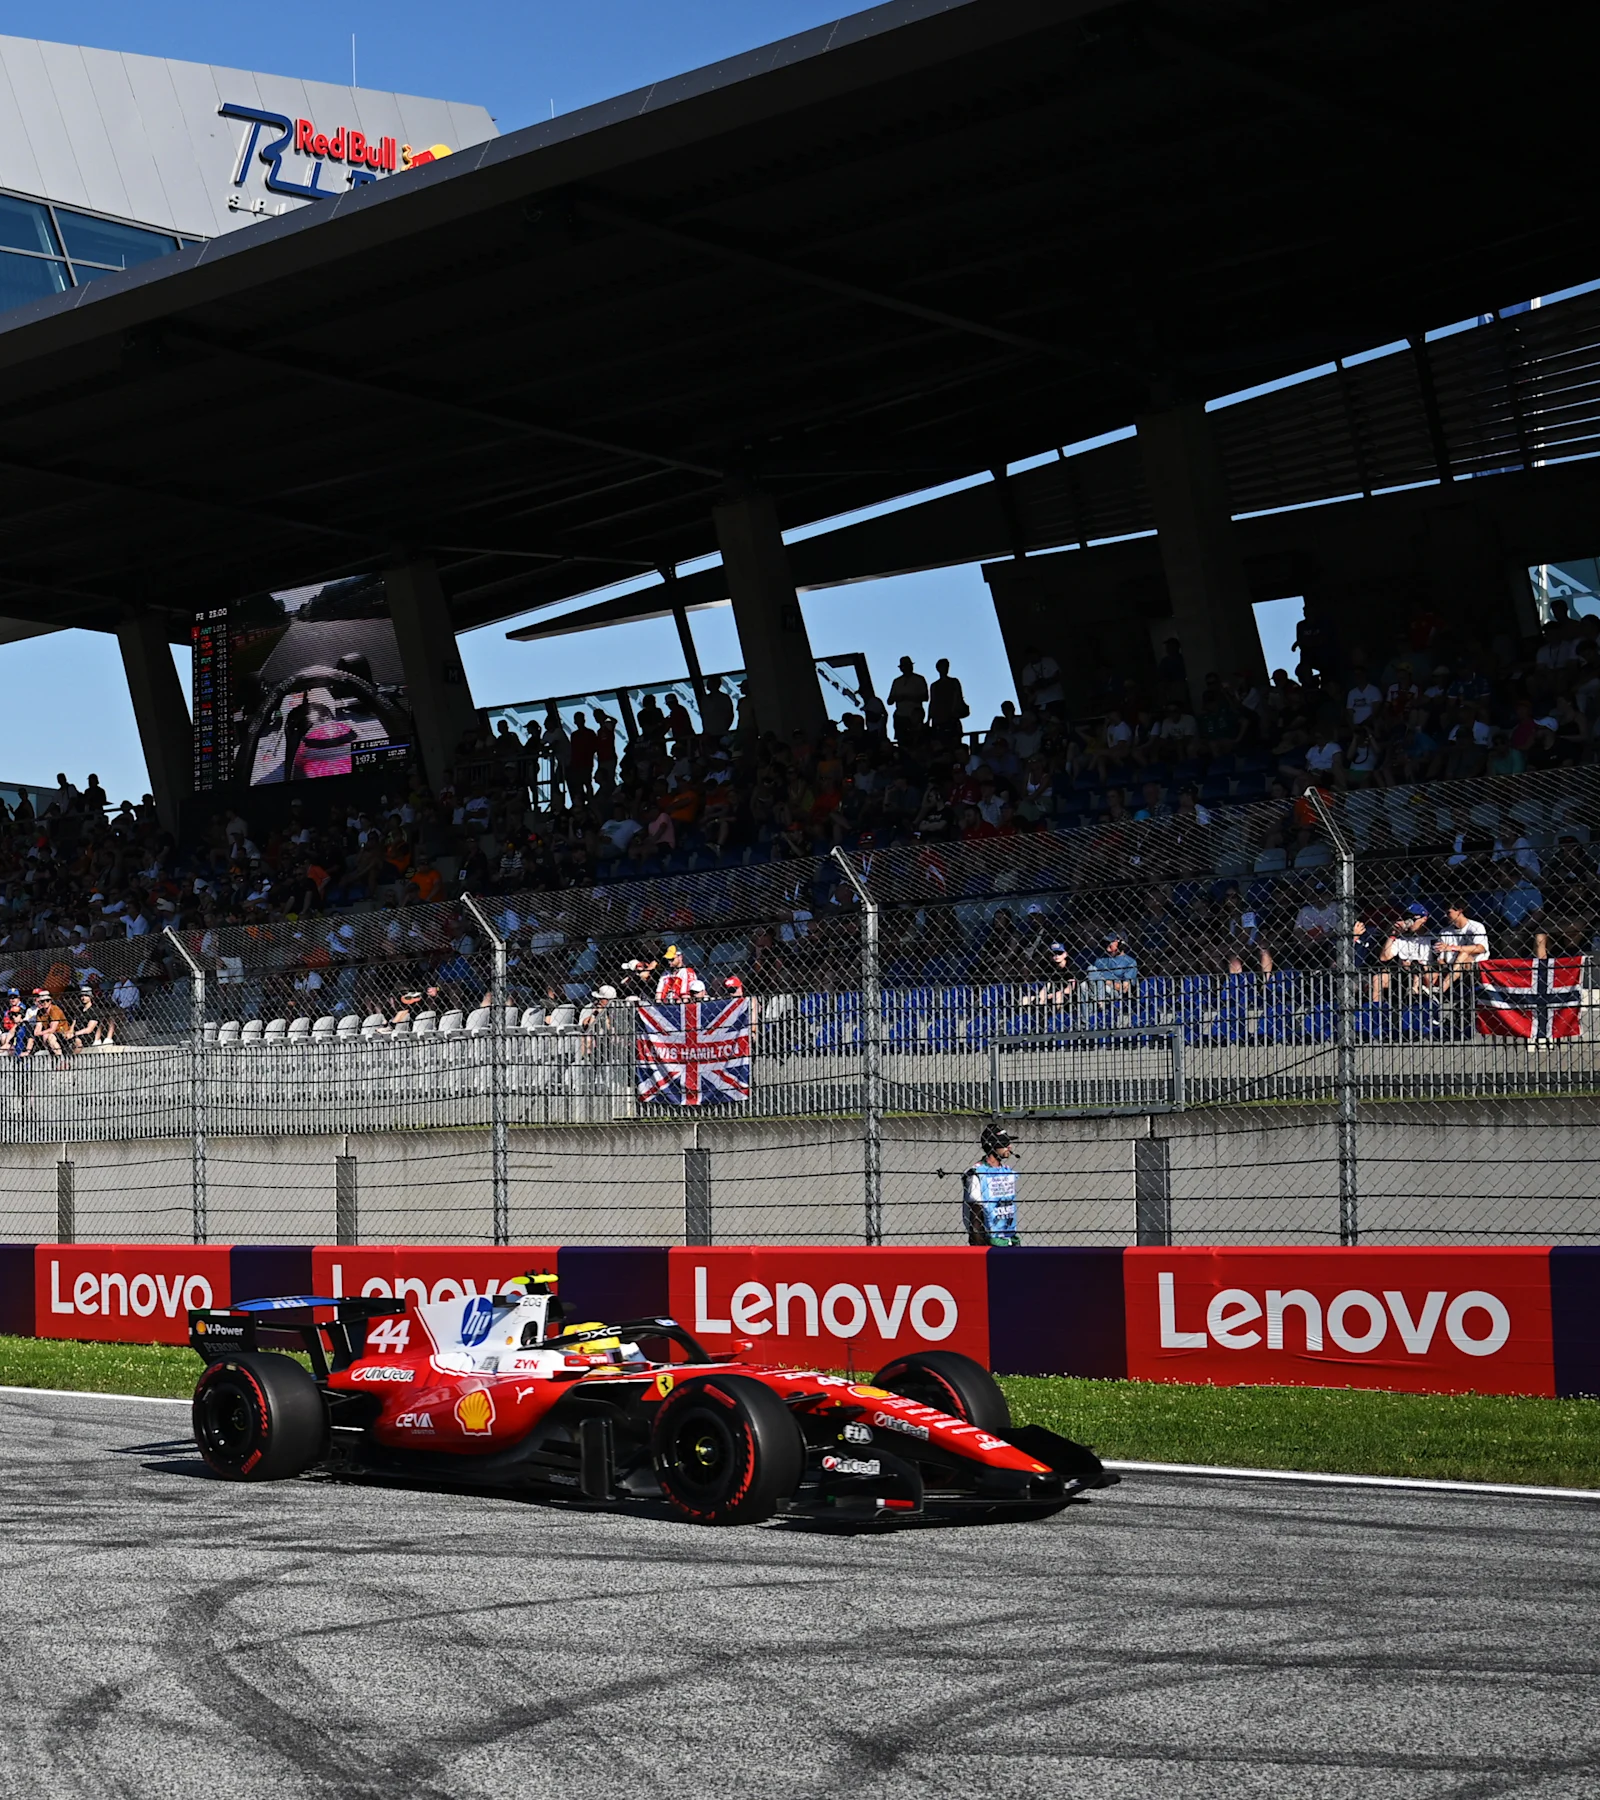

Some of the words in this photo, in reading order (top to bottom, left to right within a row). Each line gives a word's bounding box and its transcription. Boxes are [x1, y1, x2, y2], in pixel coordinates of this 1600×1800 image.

[297, 119, 345, 159] Red
[348, 131, 396, 171] Bull
[50, 1261, 214, 1317] Lenovo
[695, 1266, 958, 1341] Lenovo
[205, 1324, 244, 1336] V-Power
[463, 1297, 491, 1347] hp
[1158, 1272, 1510, 1356] Lenovo
[367, 1320, 411, 1353] 44
[578, 1325, 622, 1342] DXC
[514, 1359, 540, 1369] ZYN
[885, 1415, 928, 1441] UniCredit
[835, 1457, 879, 1475] UniCredit
